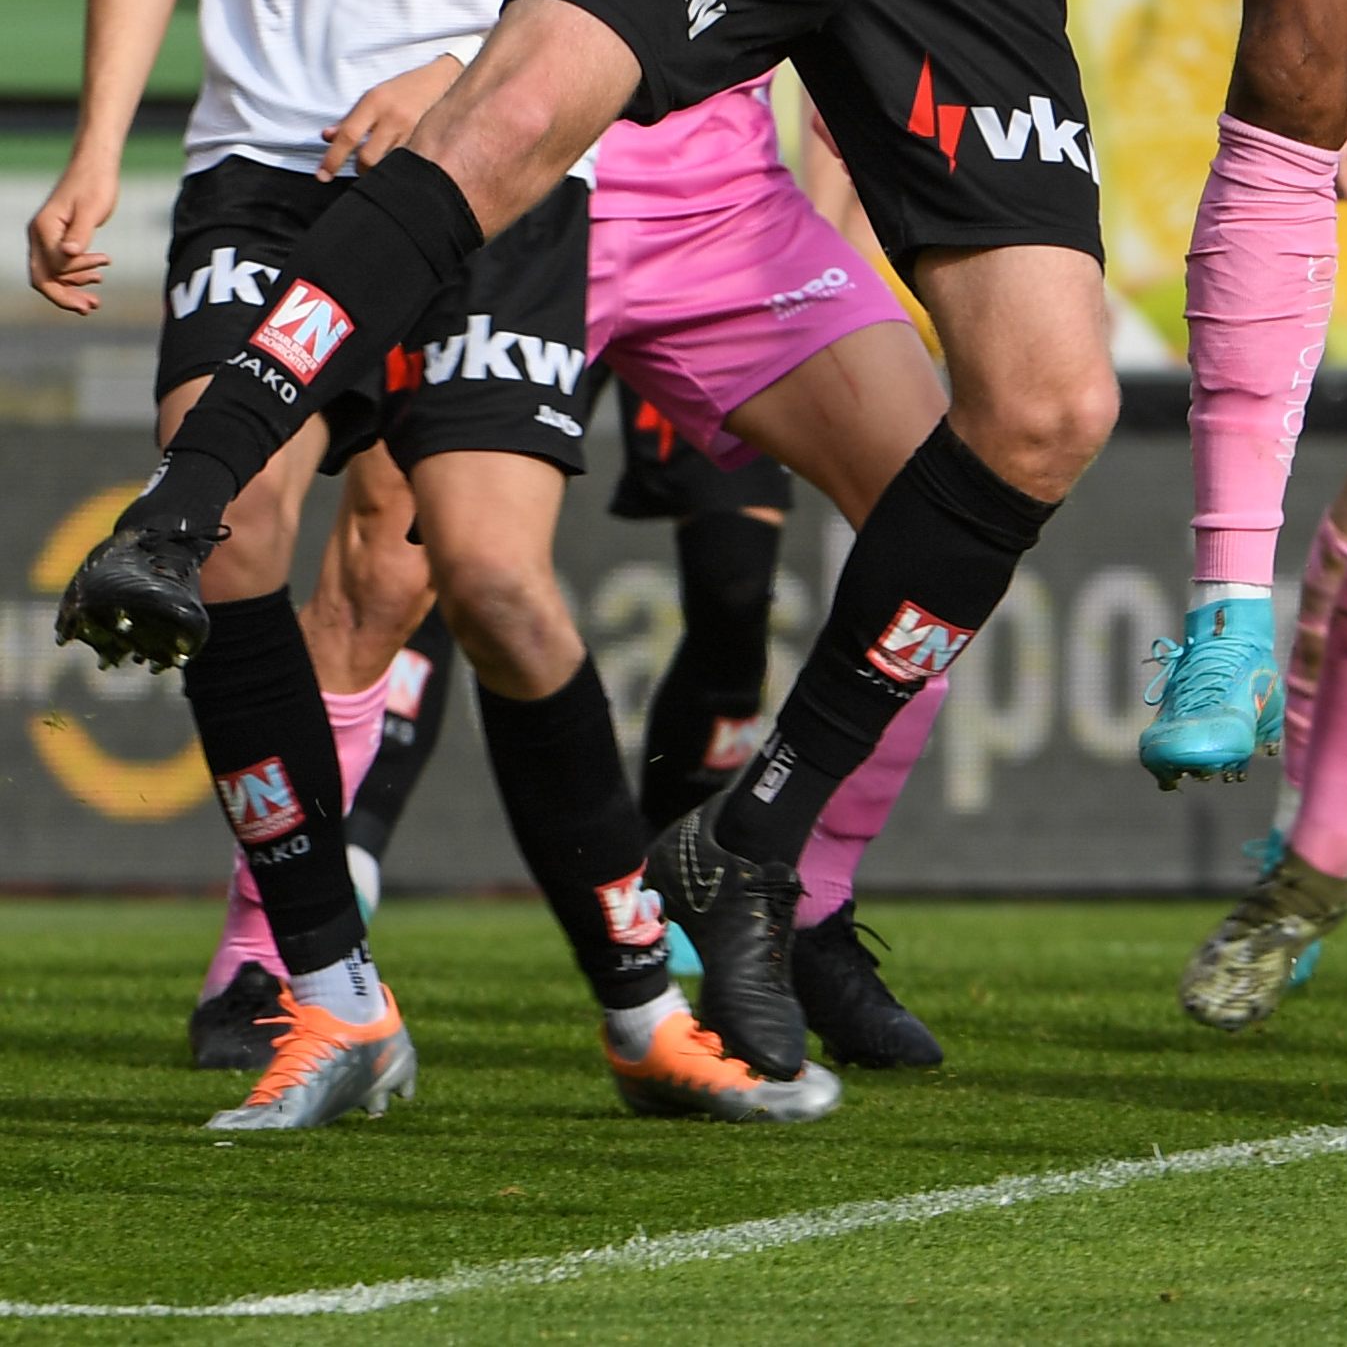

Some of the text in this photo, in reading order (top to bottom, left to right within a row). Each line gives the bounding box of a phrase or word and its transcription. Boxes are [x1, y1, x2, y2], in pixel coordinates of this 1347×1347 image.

[971, 95, 1099, 185] vk
[171, 247, 281, 320] vk
[269, 285, 348, 362] VN
[424, 315, 585, 396] vkw
[226, 350, 298, 404] JAKO
[884, 607, 968, 671] VN
[217, 763, 292, 824] VN
[252, 833, 312, 865] AKO
